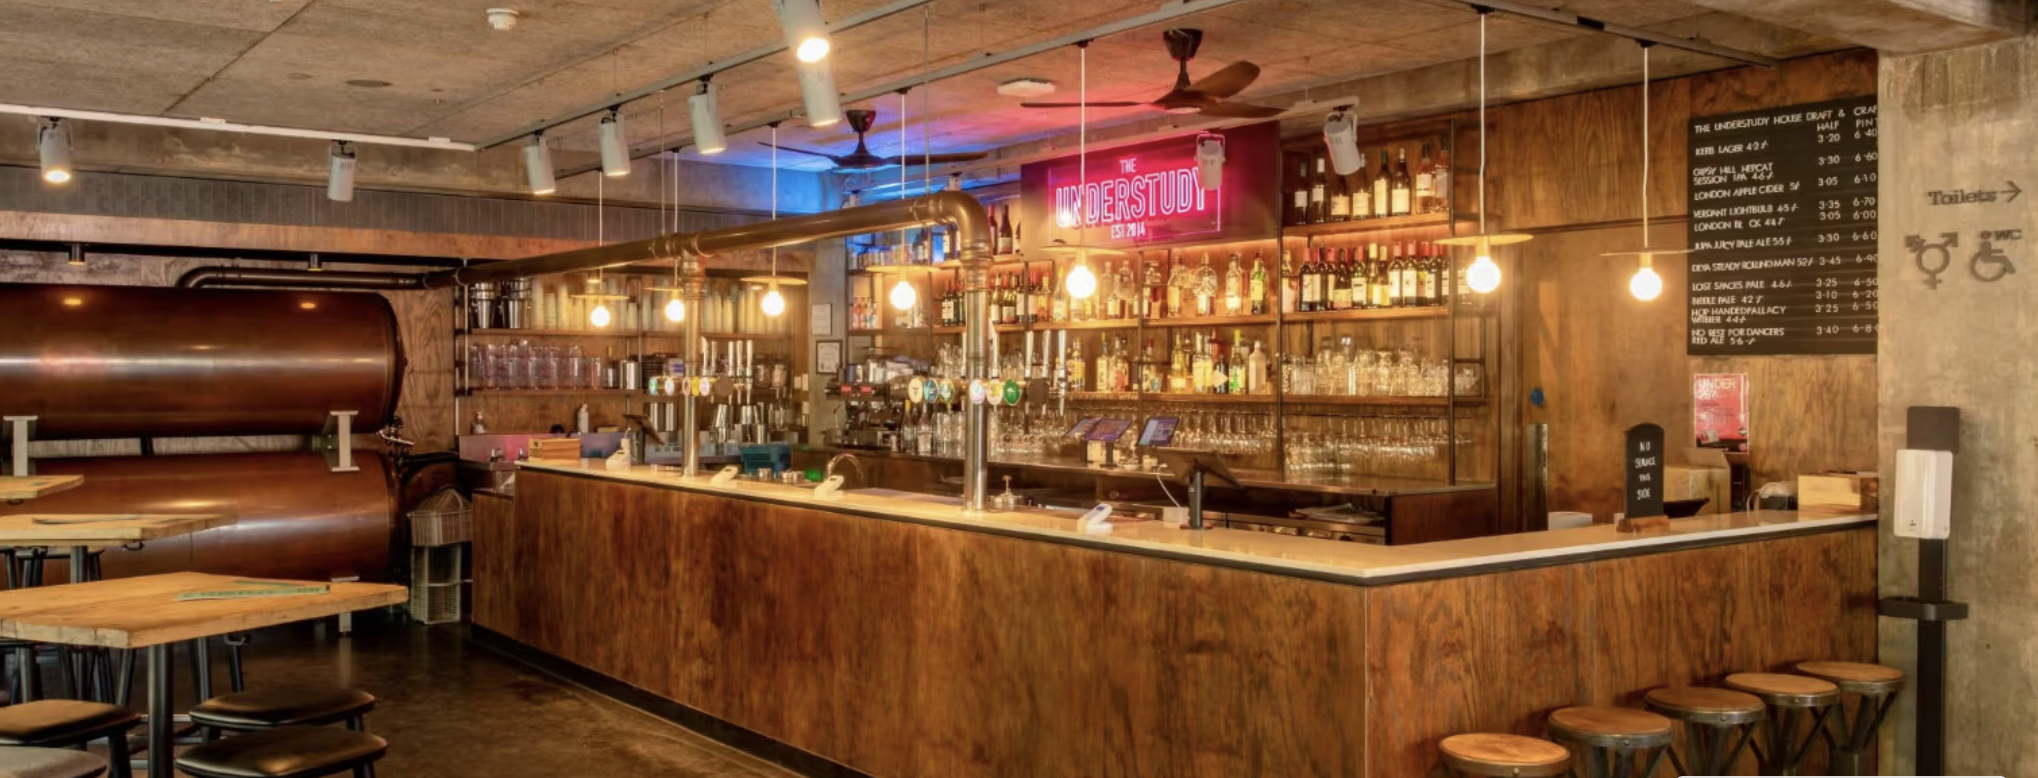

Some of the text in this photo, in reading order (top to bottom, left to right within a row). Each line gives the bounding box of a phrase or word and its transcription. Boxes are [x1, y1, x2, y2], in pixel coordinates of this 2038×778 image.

[1694, 123, 1711, 134] THE
[1714, 117, 1770, 131] UNDERSTUDY
[1774, 112, 1803, 125] HOUSE
[1806, 110, 1833, 122] DRAFT
[1838, 109, 1845, 118] &
[1816, 117, 1878, 132] HALF PIN
[1695, 145, 1715, 156] KERB
[1718, 143, 1744, 154] LAGER
[1119, 157, 1137, 175] THE
[1692, 166, 1716, 177] GIPSY
[1720, 165, 1736, 174] HILL
[1692, 174, 1728, 186] SESSION
[1055, 166, 1205, 229] UNDERSTUDY
[1694, 189, 1731, 201] LONDON
[1732, 186, 1758, 197] APPLE
[1758, 183, 1785, 194] CIDER
[1928, 188, 1998, 206] Toilets
[1728, 203, 1774, 216] LIGHTBULB
[1110, 220, 1146, 240] EST 2014
[1694, 220, 1732, 232] LONDON
[1993, 228, 2022, 242] WC
[1736, 238, 1755, 249] PALE
[1755, 237, 1771, 247] ALE
[1711, 261, 1741, 272] STEADY
[1692, 281, 1712, 291] LOST
[1714, 280, 1743, 290] SPACES
[1745, 280, 1765, 289] PALE
[1717, 295, 1736, 305] PALE
[1691, 307, 1709, 317] HOP
[1691, 328, 1706, 337] NO
[1728, 327, 1745, 337] FOR
[1691, 336, 1708, 345] RED
[1710, 336, 1725, 345] ALE
[1697, 377, 1736, 390] UNDER
[1639, 441, 1651, 452] NO
[1637, 487, 1651, 500] SIDE
